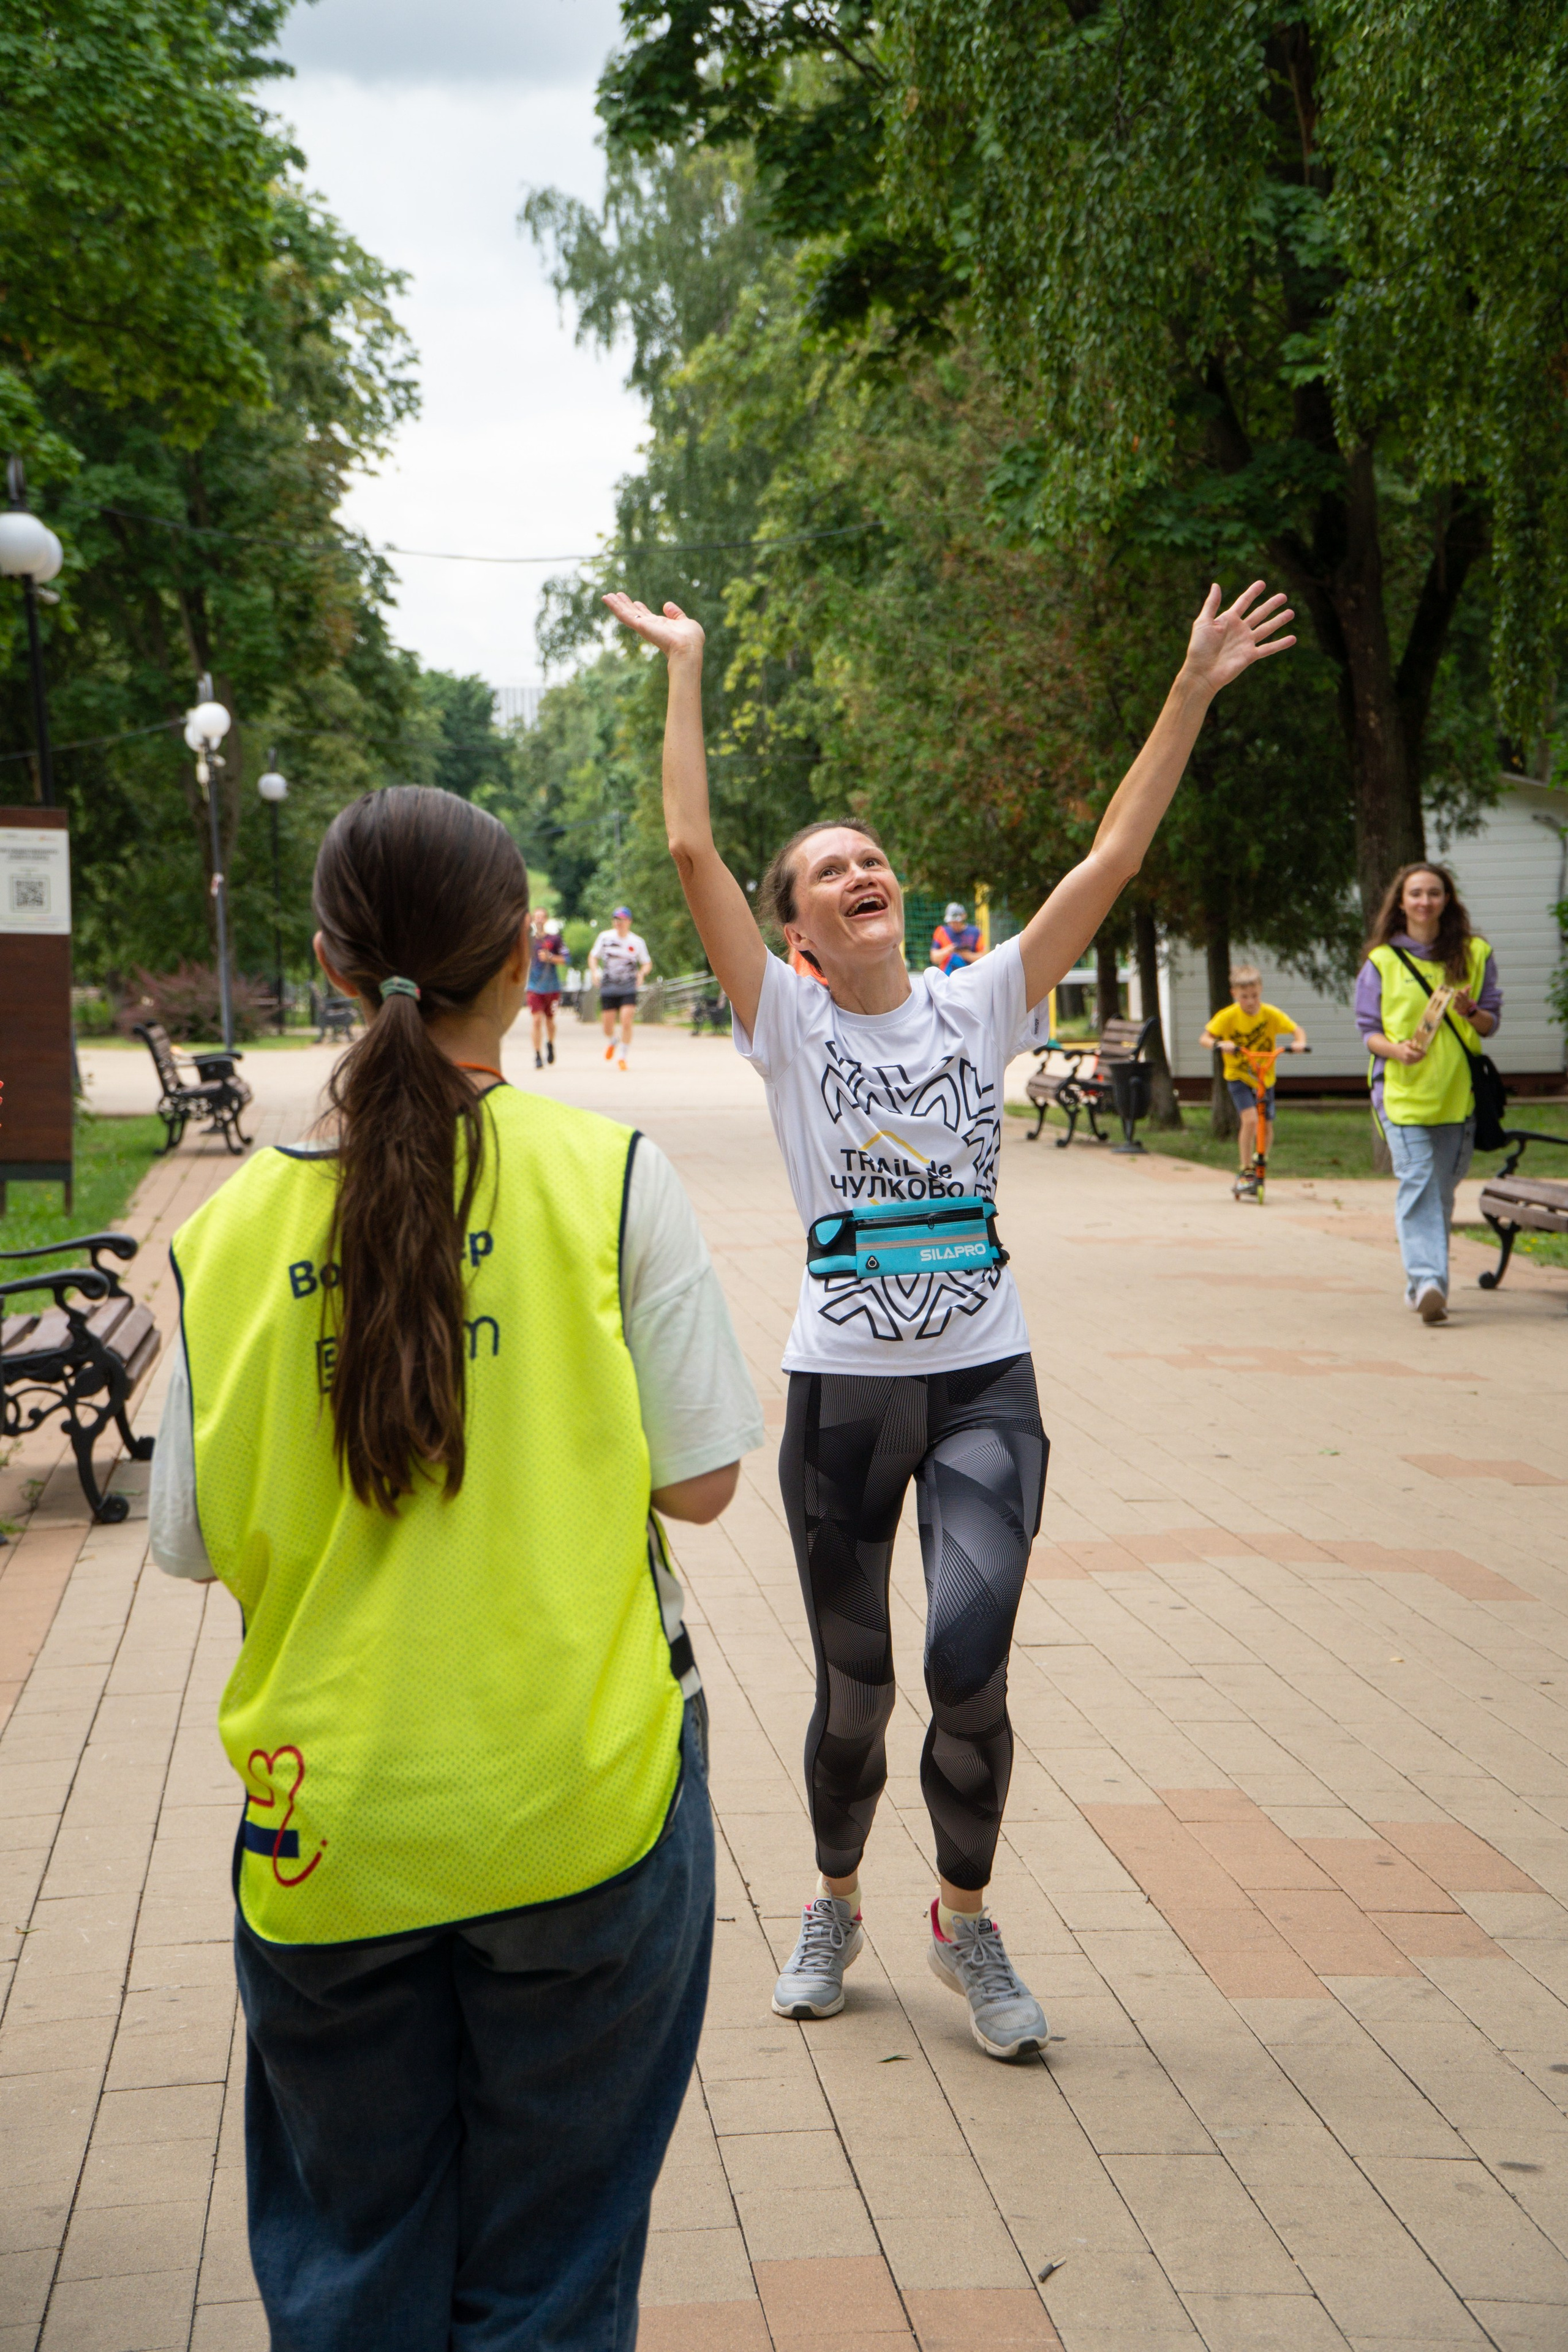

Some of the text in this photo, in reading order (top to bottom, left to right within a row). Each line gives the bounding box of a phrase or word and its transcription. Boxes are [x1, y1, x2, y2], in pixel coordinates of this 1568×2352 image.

[925, 1160, 952, 1179] de
[831, 1175, 964, 1200] ЧУЛКОВО
[921, 1243, 986, 1262] SILAPRO
